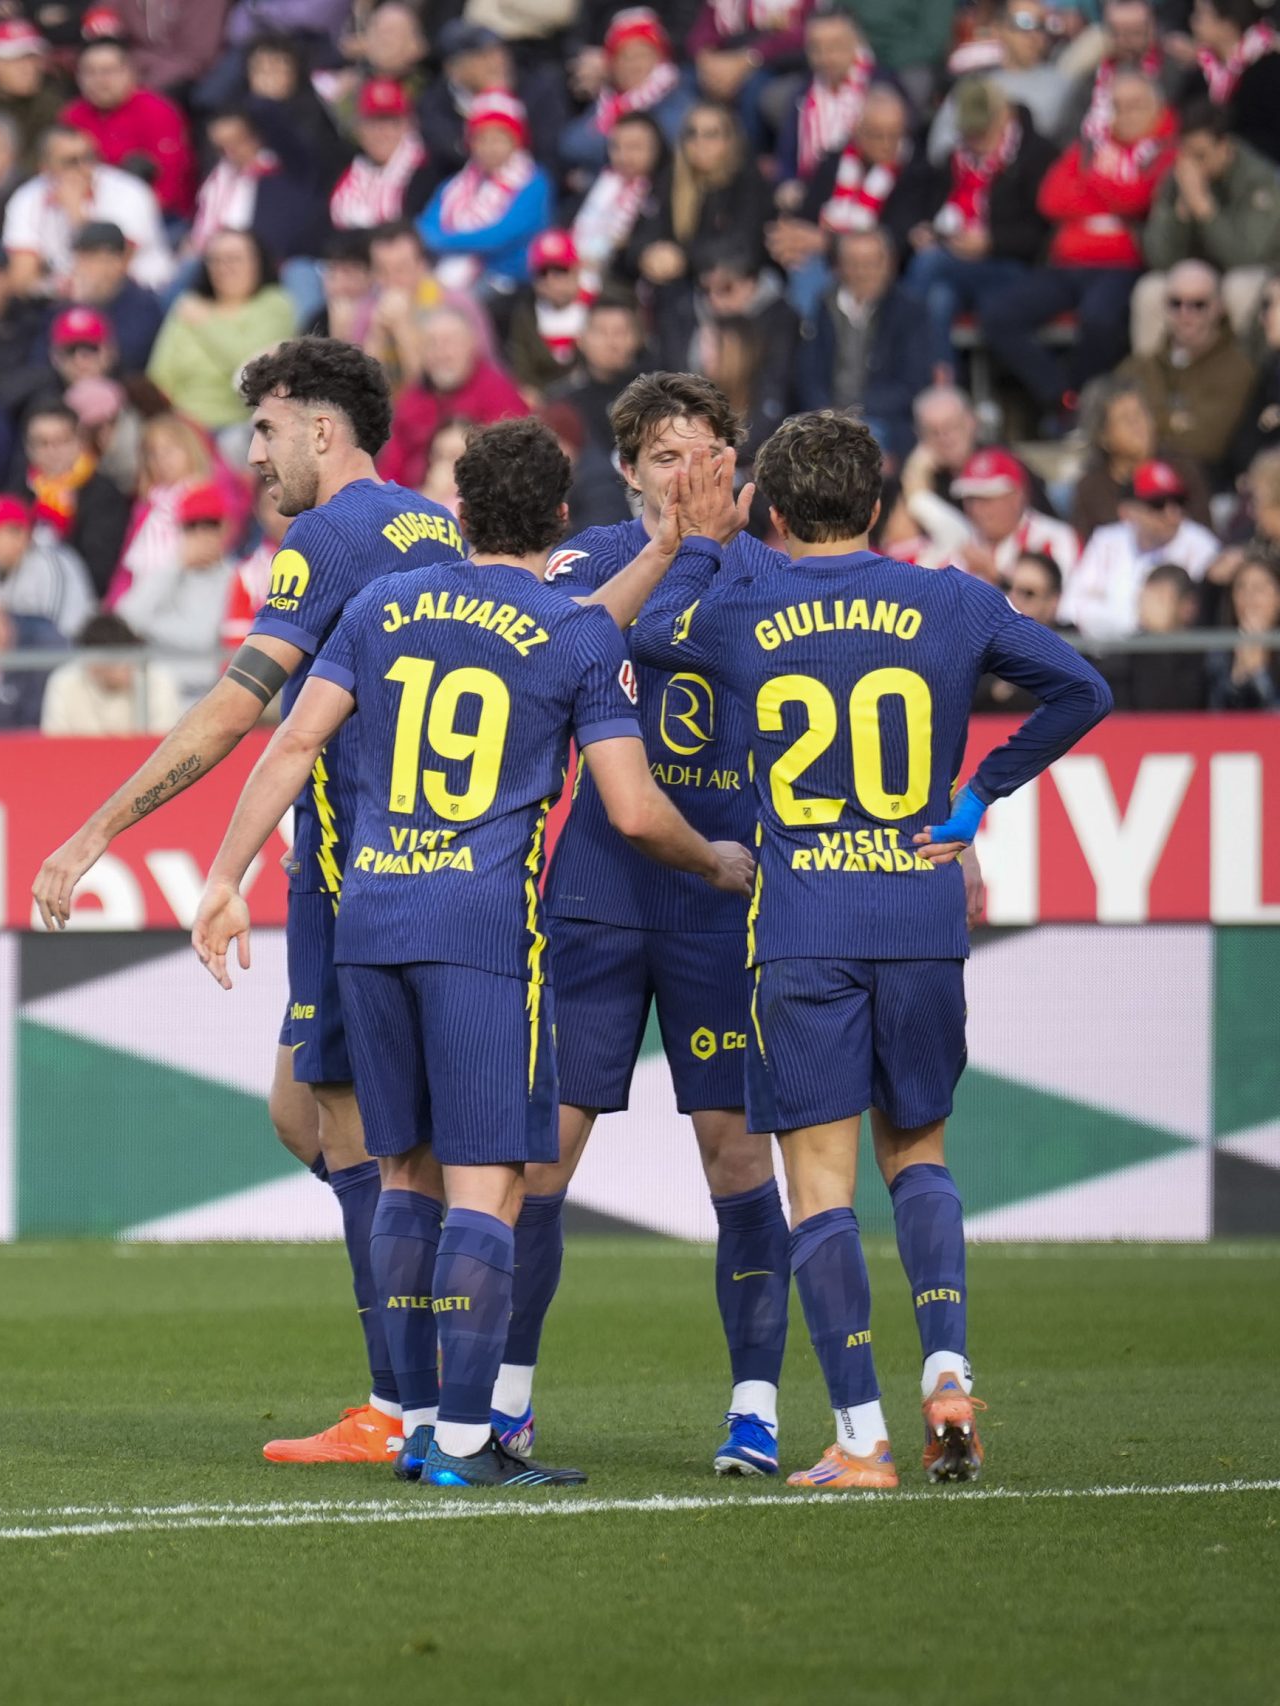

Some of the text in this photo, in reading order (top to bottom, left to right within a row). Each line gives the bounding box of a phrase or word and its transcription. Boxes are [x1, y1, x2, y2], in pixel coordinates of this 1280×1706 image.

[381, 512, 465, 559] RUGGER
[754, 598, 923, 651] GIULIANO
[384, 656, 511, 823] 19
[755, 666, 932, 826] 20
[706, 769, 741, 790] AIR
[818, 828, 900, 854] VISIT
[354, 846, 474, 875] RWANDA
[916, 1288, 961, 1308] ATLETI
